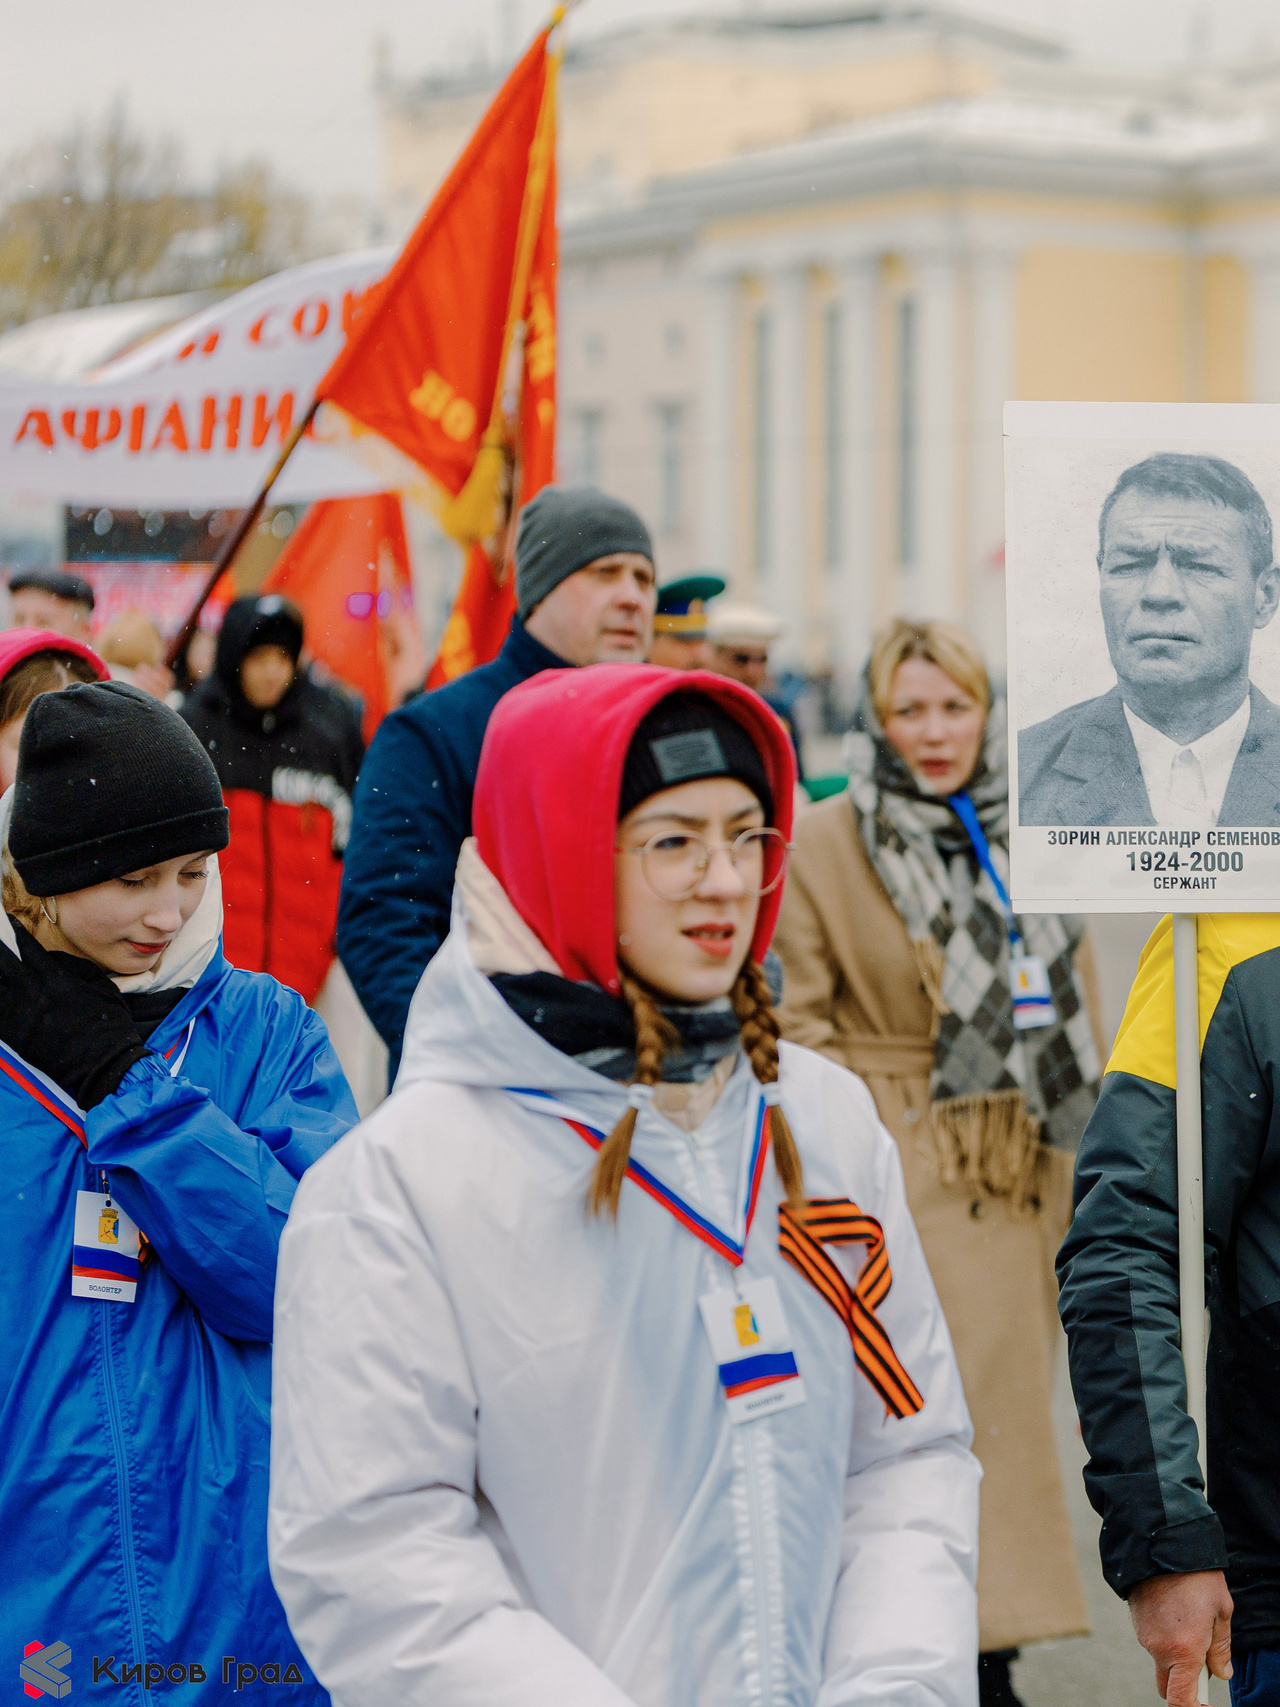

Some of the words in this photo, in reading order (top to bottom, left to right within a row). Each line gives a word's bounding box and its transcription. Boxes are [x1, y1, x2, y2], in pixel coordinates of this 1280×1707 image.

[1048, 831, 1100, 846] ЗОРИН
[1106, 831, 1201, 848] АЛЕКСАНДР
[1126, 851, 1244, 872] 1924-2000
[1153, 877, 1217, 890] СЕРЖАНТ
[88, 1284, 123, 1294] ВОЛОНТЕР
